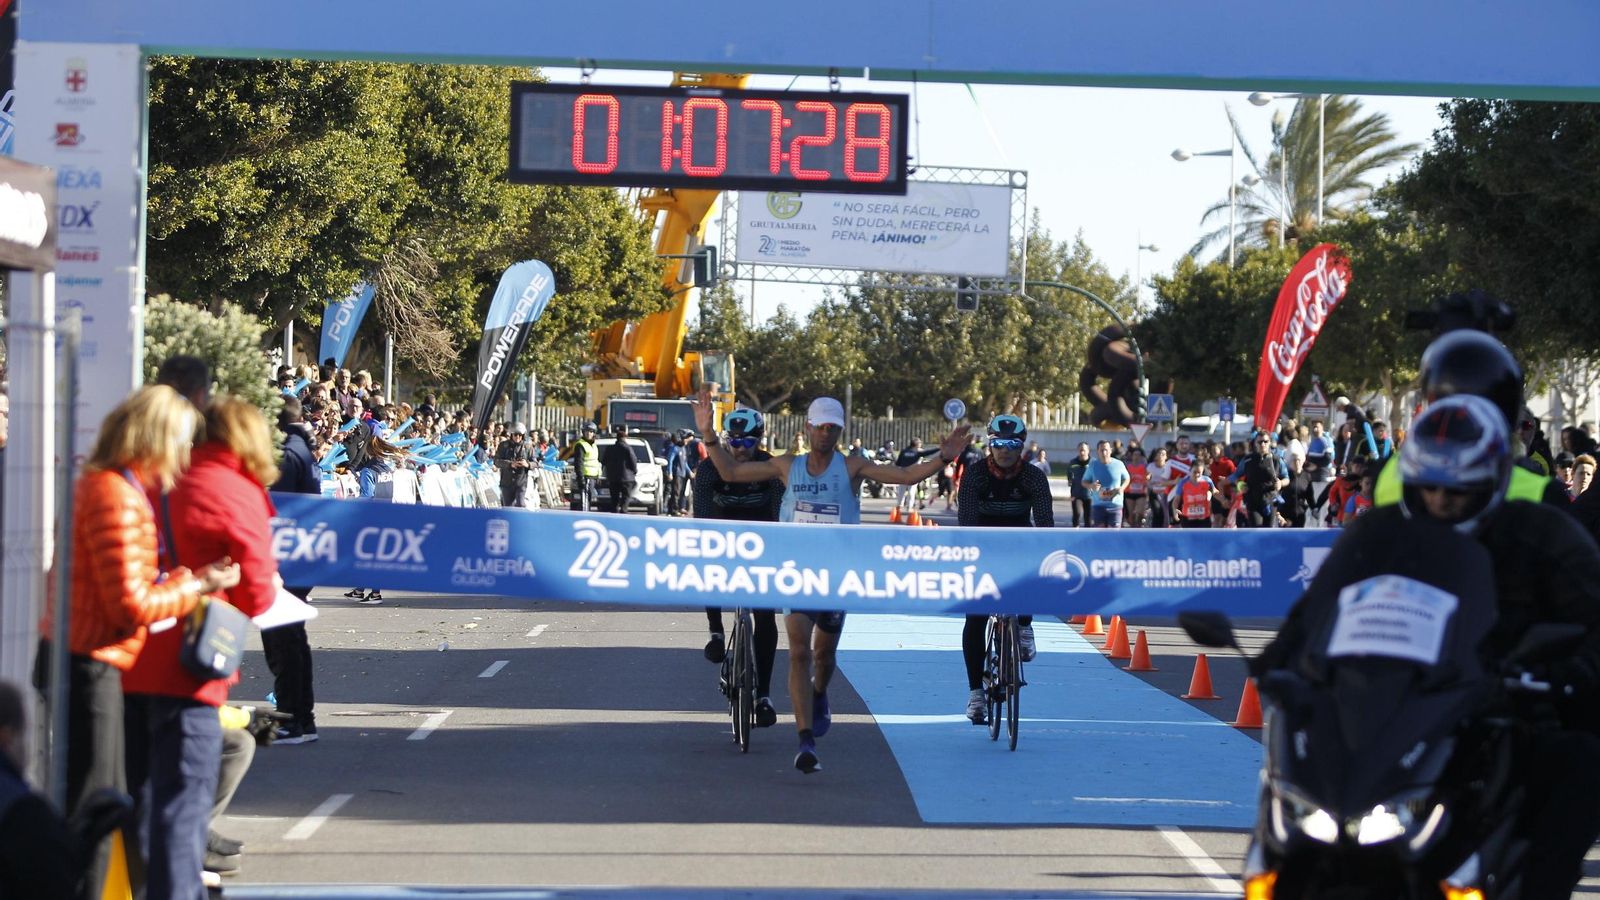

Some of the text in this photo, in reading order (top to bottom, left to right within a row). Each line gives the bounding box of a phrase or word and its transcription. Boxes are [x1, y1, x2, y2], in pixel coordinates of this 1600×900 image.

[843, 202, 864, 213] NO
[866, 203, 900, 215] SERÁ
[902, 205, 941, 218] FÁCIL,
[944, 207, 980, 219] PERO
[831, 216, 990, 234] SIN DUDA, MERECERÁ LA
[871, 231, 926, 245] ¡ÁNIMO!
[480, 273, 549, 391] POWERADE
[793, 482, 828, 495] nerja
[354, 523, 435, 563] CDX
[645, 526, 765, 561] MEDIO
[881, 543, 981, 562] 03/02/2019
[452, 556, 536, 576] ALMERÍA
[645, 559, 1001, 602] MARATÓN ALMERÍA
